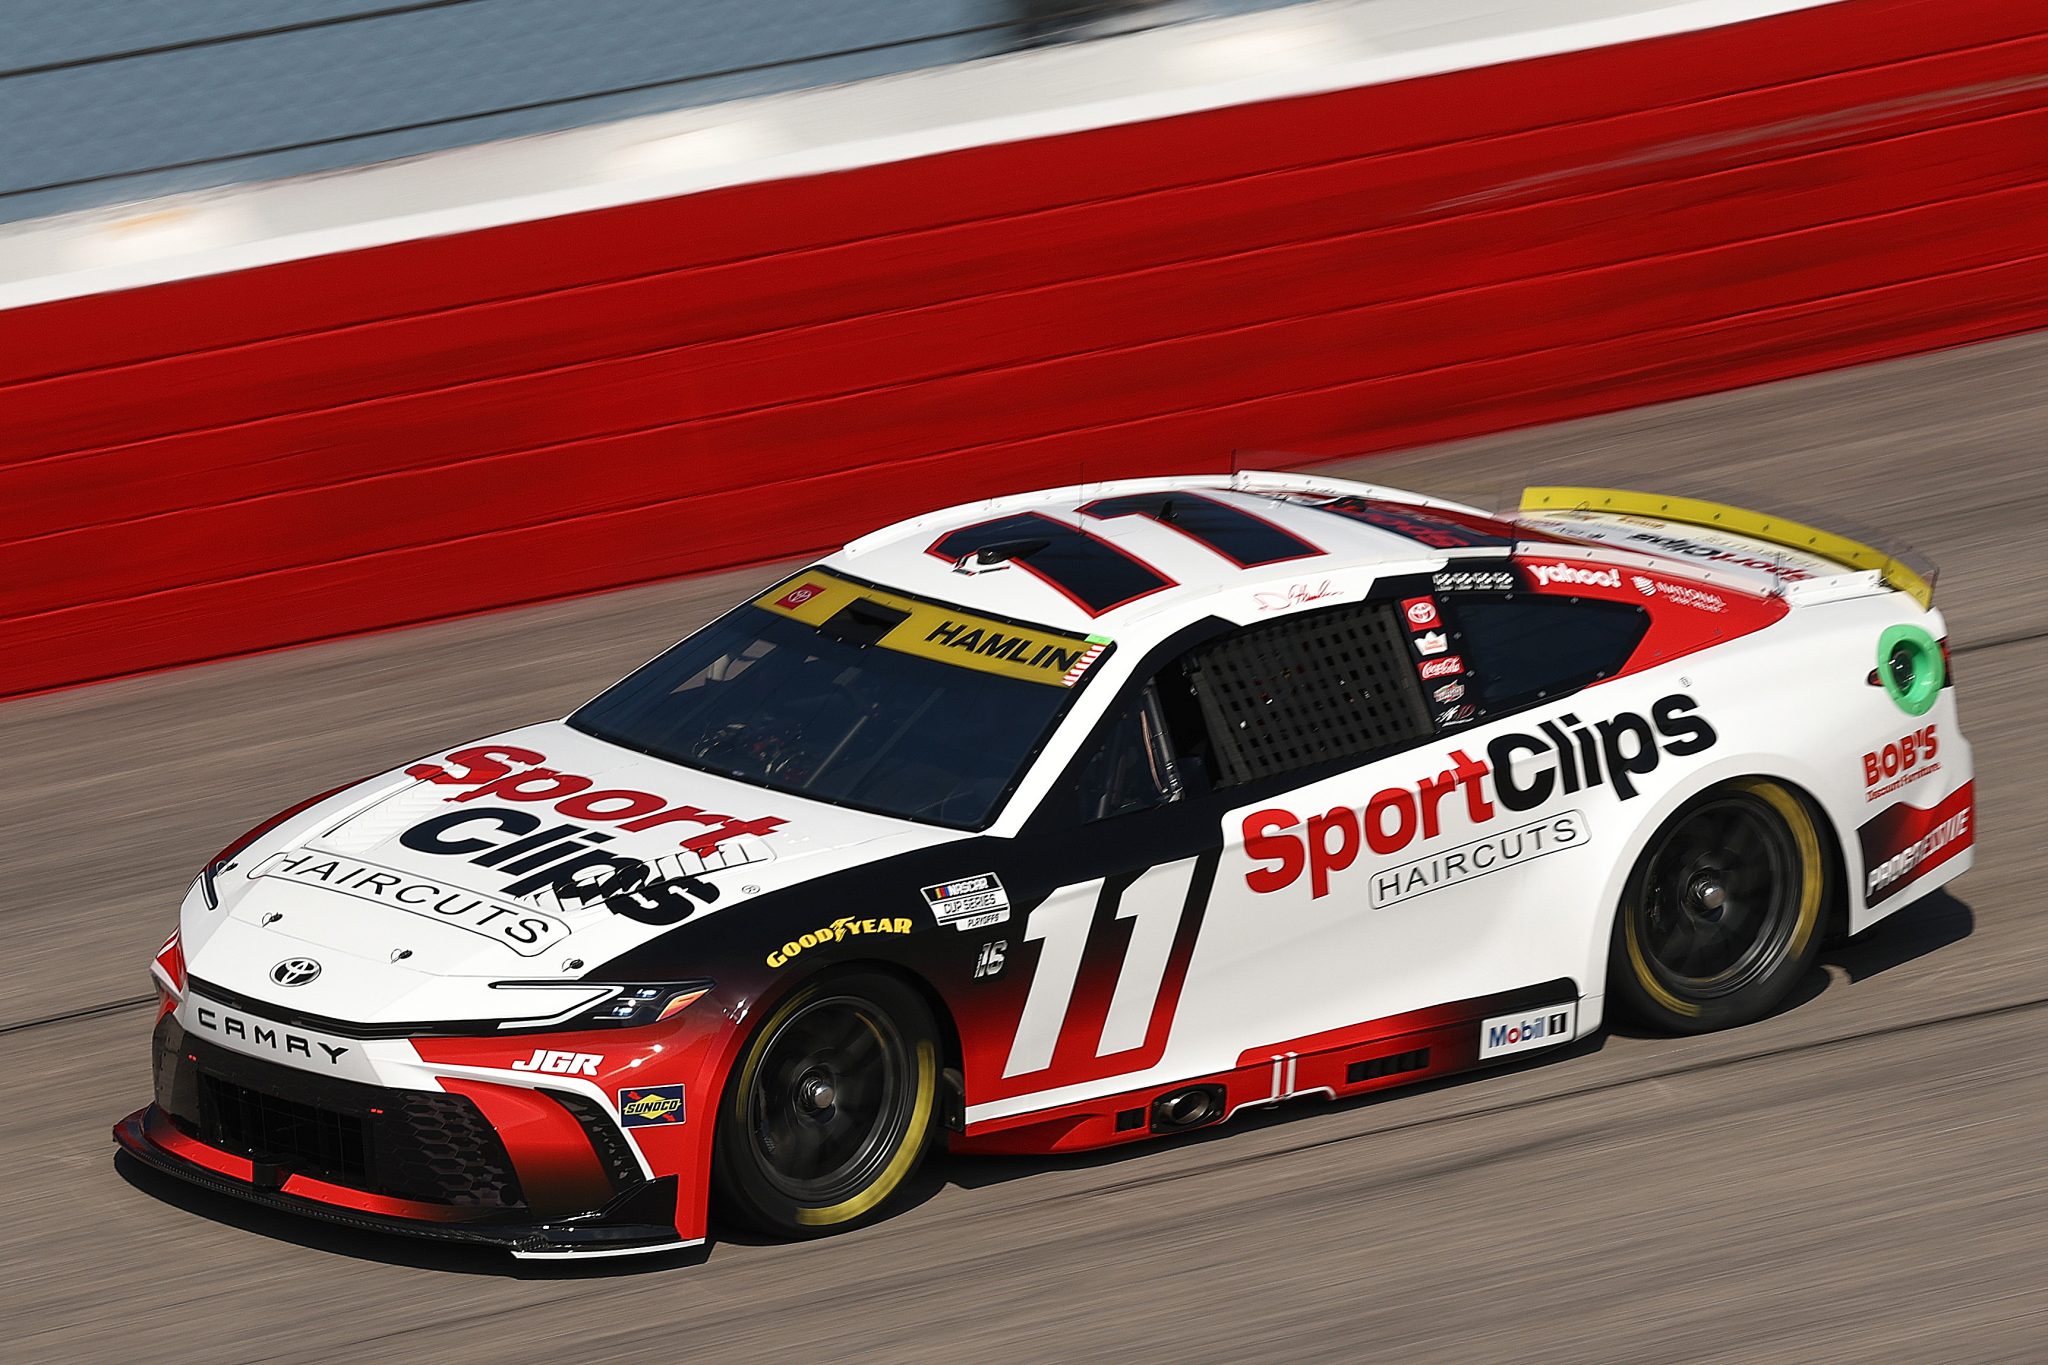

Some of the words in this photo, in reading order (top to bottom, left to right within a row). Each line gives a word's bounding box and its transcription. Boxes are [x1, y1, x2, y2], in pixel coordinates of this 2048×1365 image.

[924, 491, 1331, 619] 11
[1527, 563, 1622, 588] yahoo!
[924, 621, 1084, 672] HAMLIN
[1863, 724, 1938, 788] BOB'S
[404, 745, 792, 857] Sport
[399, 807, 720, 926] Clips
[1378, 818, 1577, 902] HAIRCUTS
[277, 853, 549, 944] HAIRCUTS
[944, 900, 962, 914] CUP
[963, 894, 996, 911] SERIES
[948, 877, 989, 897] NASCAR
[766, 916, 912, 968] GOODYEAR
[967, 913, 1000, 928] PLAYOFFS
[1001, 855, 1199, 1079] 11
[198, 1007, 348, 1064] CAMRY
[1489, 1016, 1545, 1048] Mobil
[511, 1049, 604, 1076] JGR
[626, 1099, 681, 1114] SUNOCO
